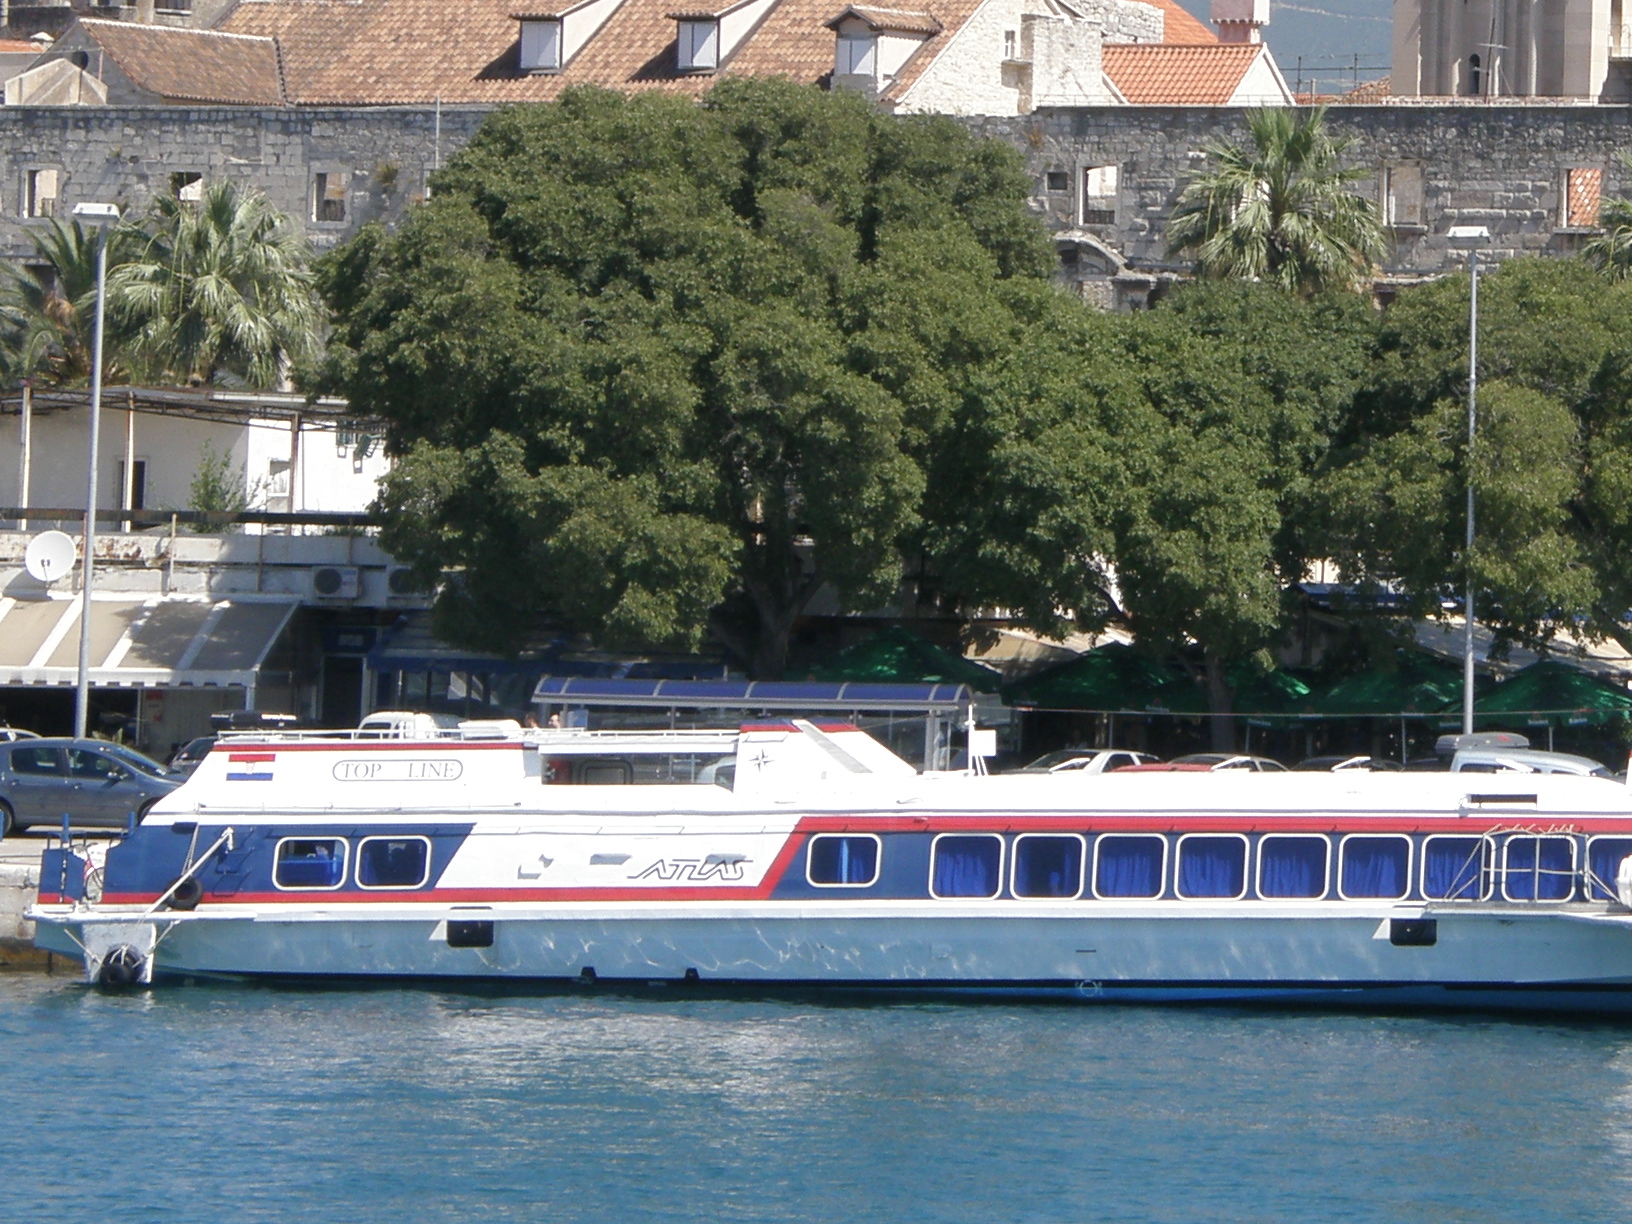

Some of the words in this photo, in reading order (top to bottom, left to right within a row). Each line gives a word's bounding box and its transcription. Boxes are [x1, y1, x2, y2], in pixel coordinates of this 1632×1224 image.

[342, 763, 382, 778] TOP
[408, 763, 455, 778] LINE
[626, 859, 754, 880] ATLAS
